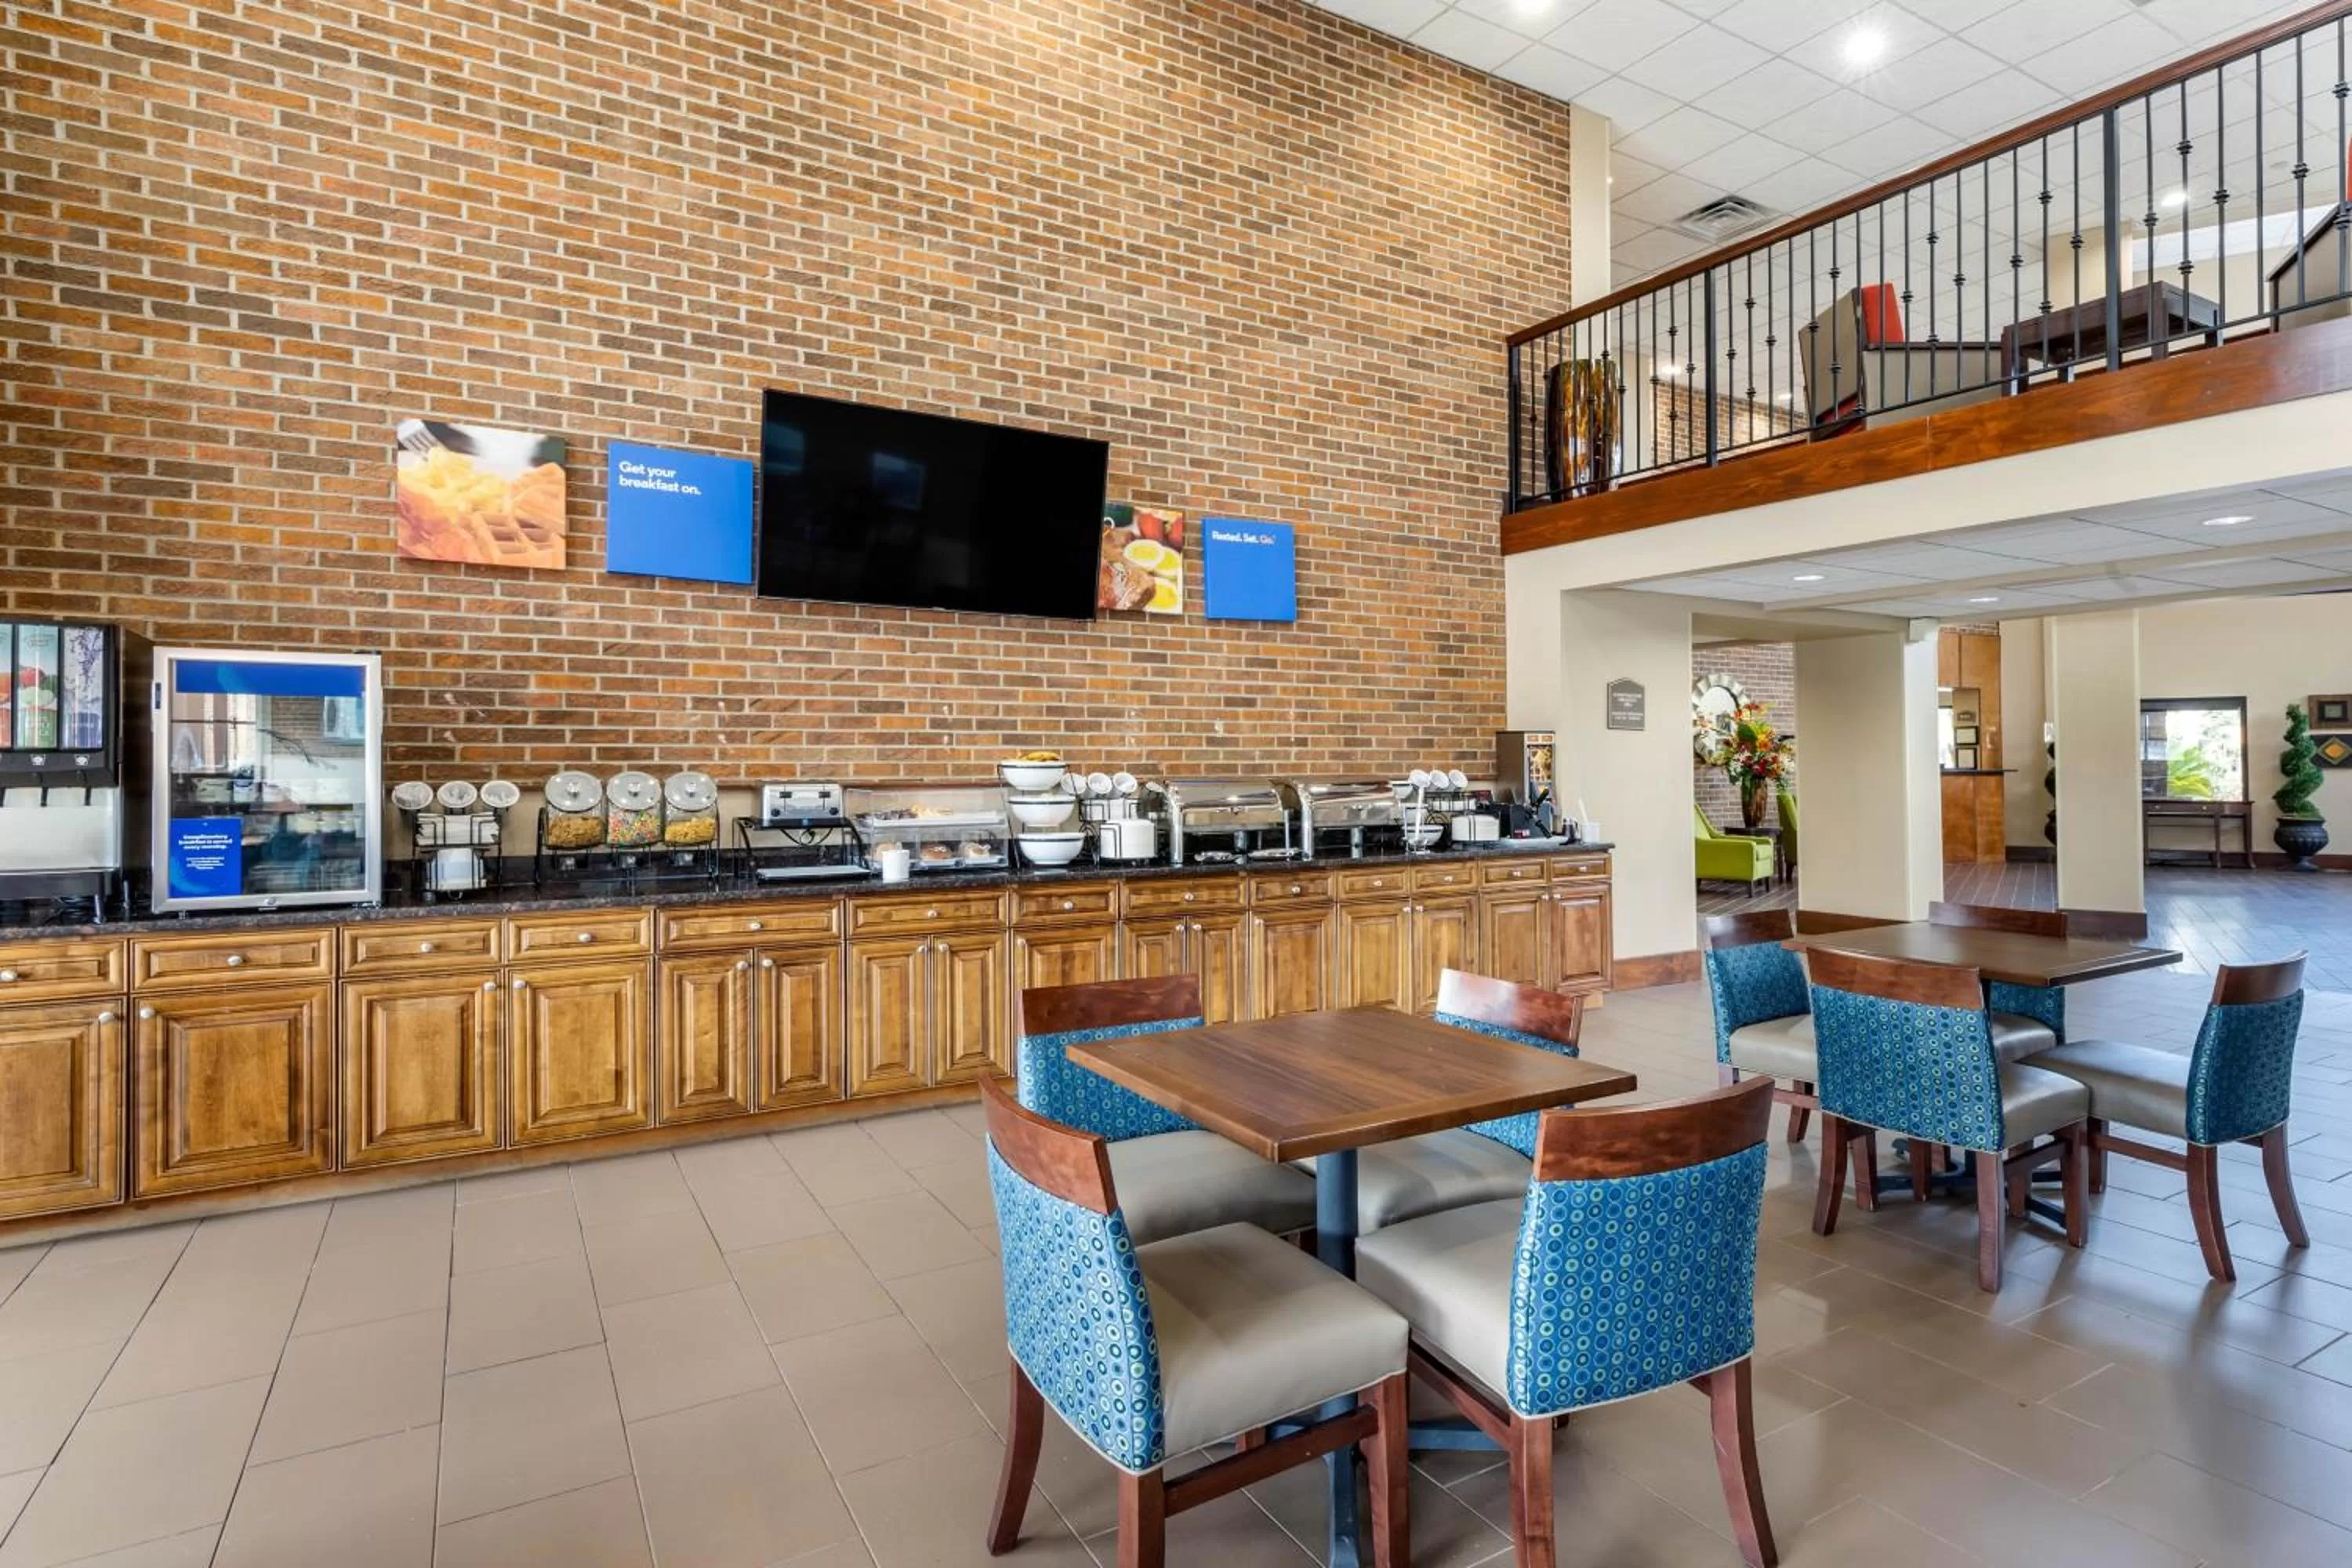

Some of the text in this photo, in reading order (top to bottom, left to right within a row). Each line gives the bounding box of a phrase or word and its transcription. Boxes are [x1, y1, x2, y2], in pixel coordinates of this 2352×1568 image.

[619, 461, 677, 478] Get your
[619, 474, 702, 495] breakfast on.
